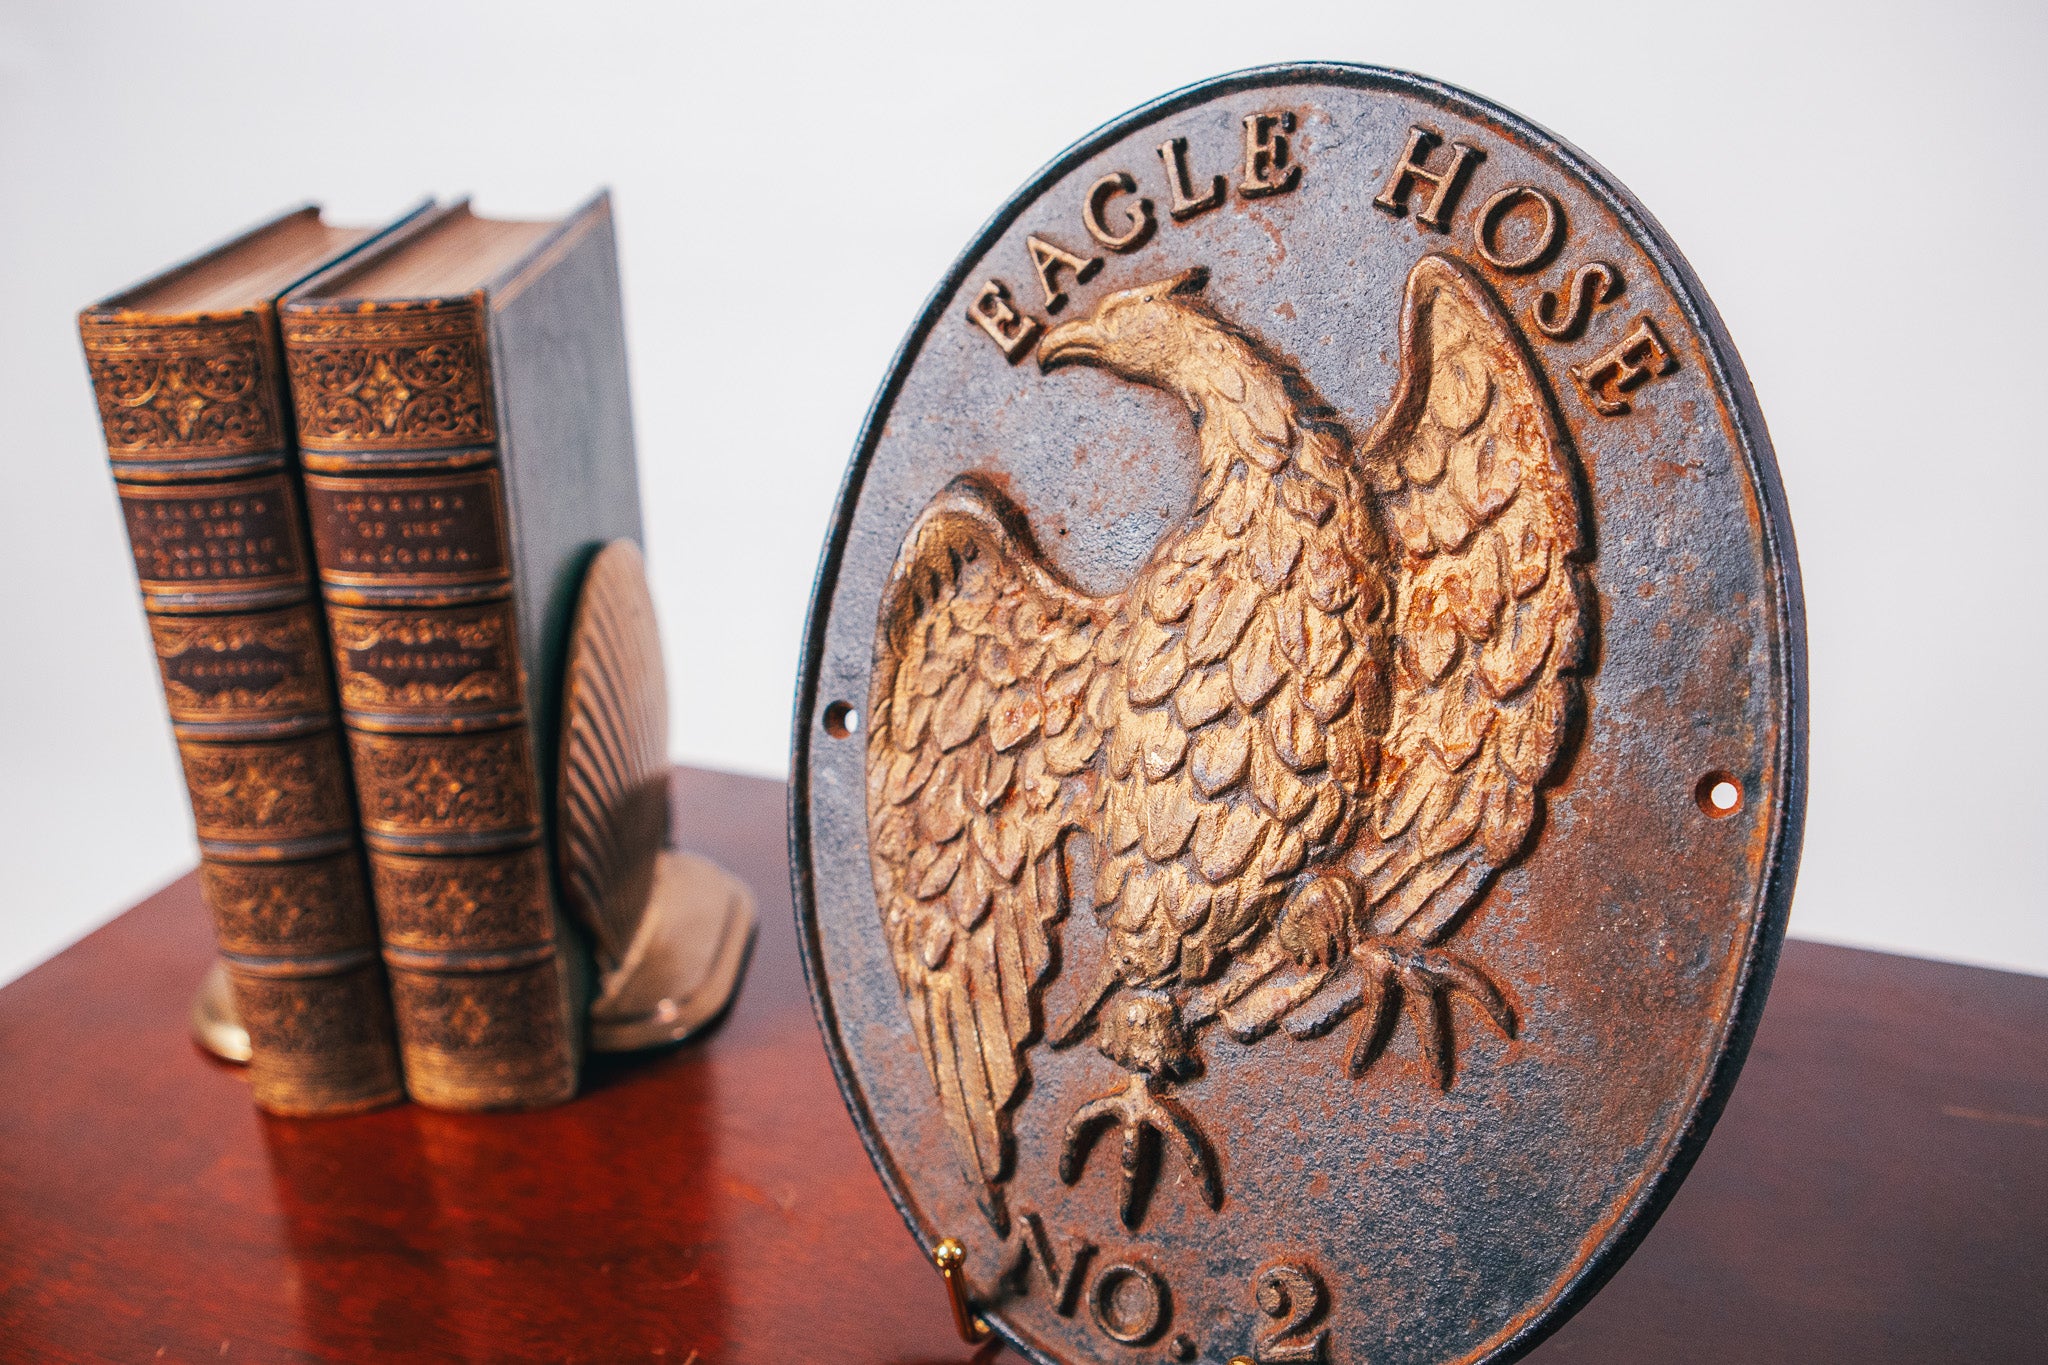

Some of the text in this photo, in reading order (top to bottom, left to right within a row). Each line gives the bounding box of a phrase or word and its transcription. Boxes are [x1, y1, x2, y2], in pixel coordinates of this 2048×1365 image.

[966, 110, 1680, 416] EAGLE HOSE
[1255, 1262, 1331, 1365] 2
